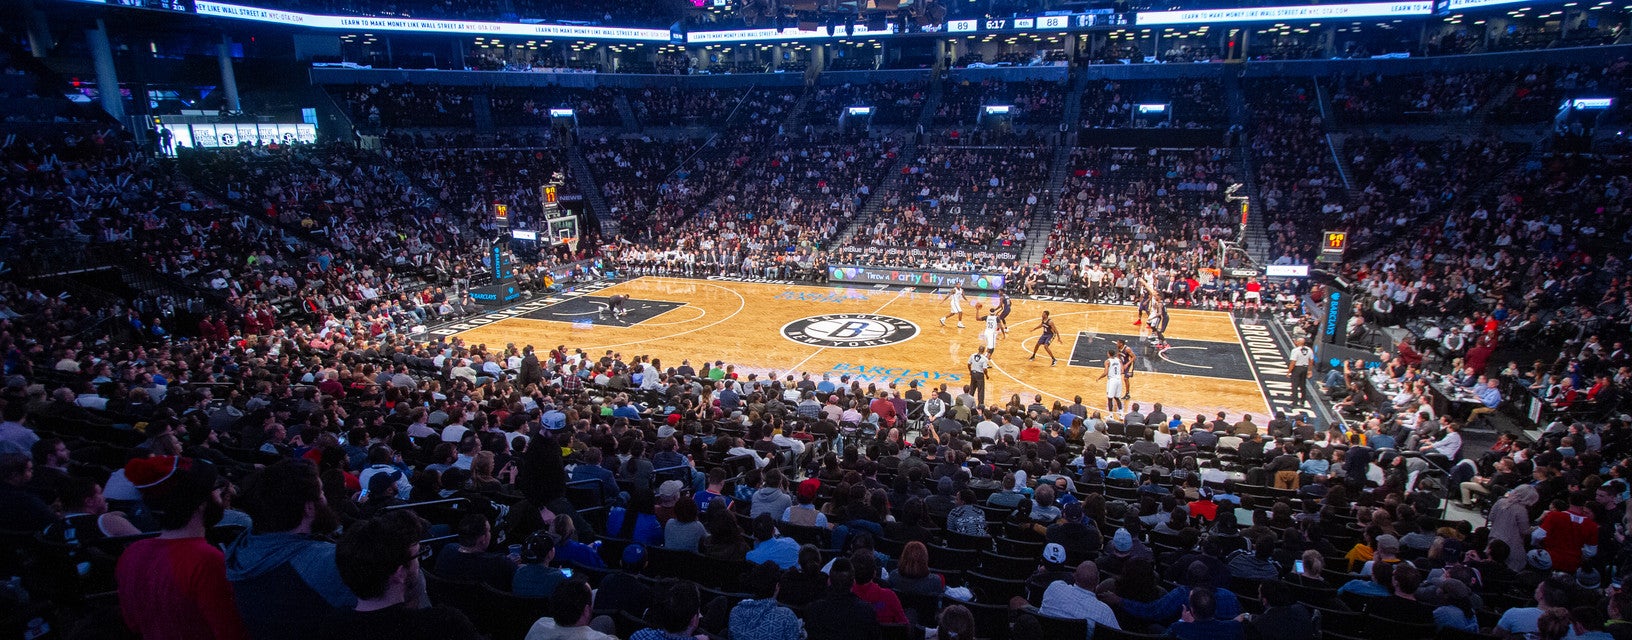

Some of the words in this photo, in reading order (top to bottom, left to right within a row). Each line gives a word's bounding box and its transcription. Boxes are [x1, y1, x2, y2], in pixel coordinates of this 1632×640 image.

[240, 9, 259, 17] STREET
[986, 20, 1005, 29] 6:17
[866, 272, 884, 280] Throw
[430, 297, 565, 335] BROOKLYN
[807, 314, 912, 329] BROOKLYN
[1326, 301, 1339, 335] BARCLAYS
[828, 321, 869, 337] B
[788, 331, 821, 344] NEW
[833, 338, 892, 347] YORK
[1240, 324, 1292, 376] BROOKLYN
[832, 364, 963, 381] BARCLAYS
